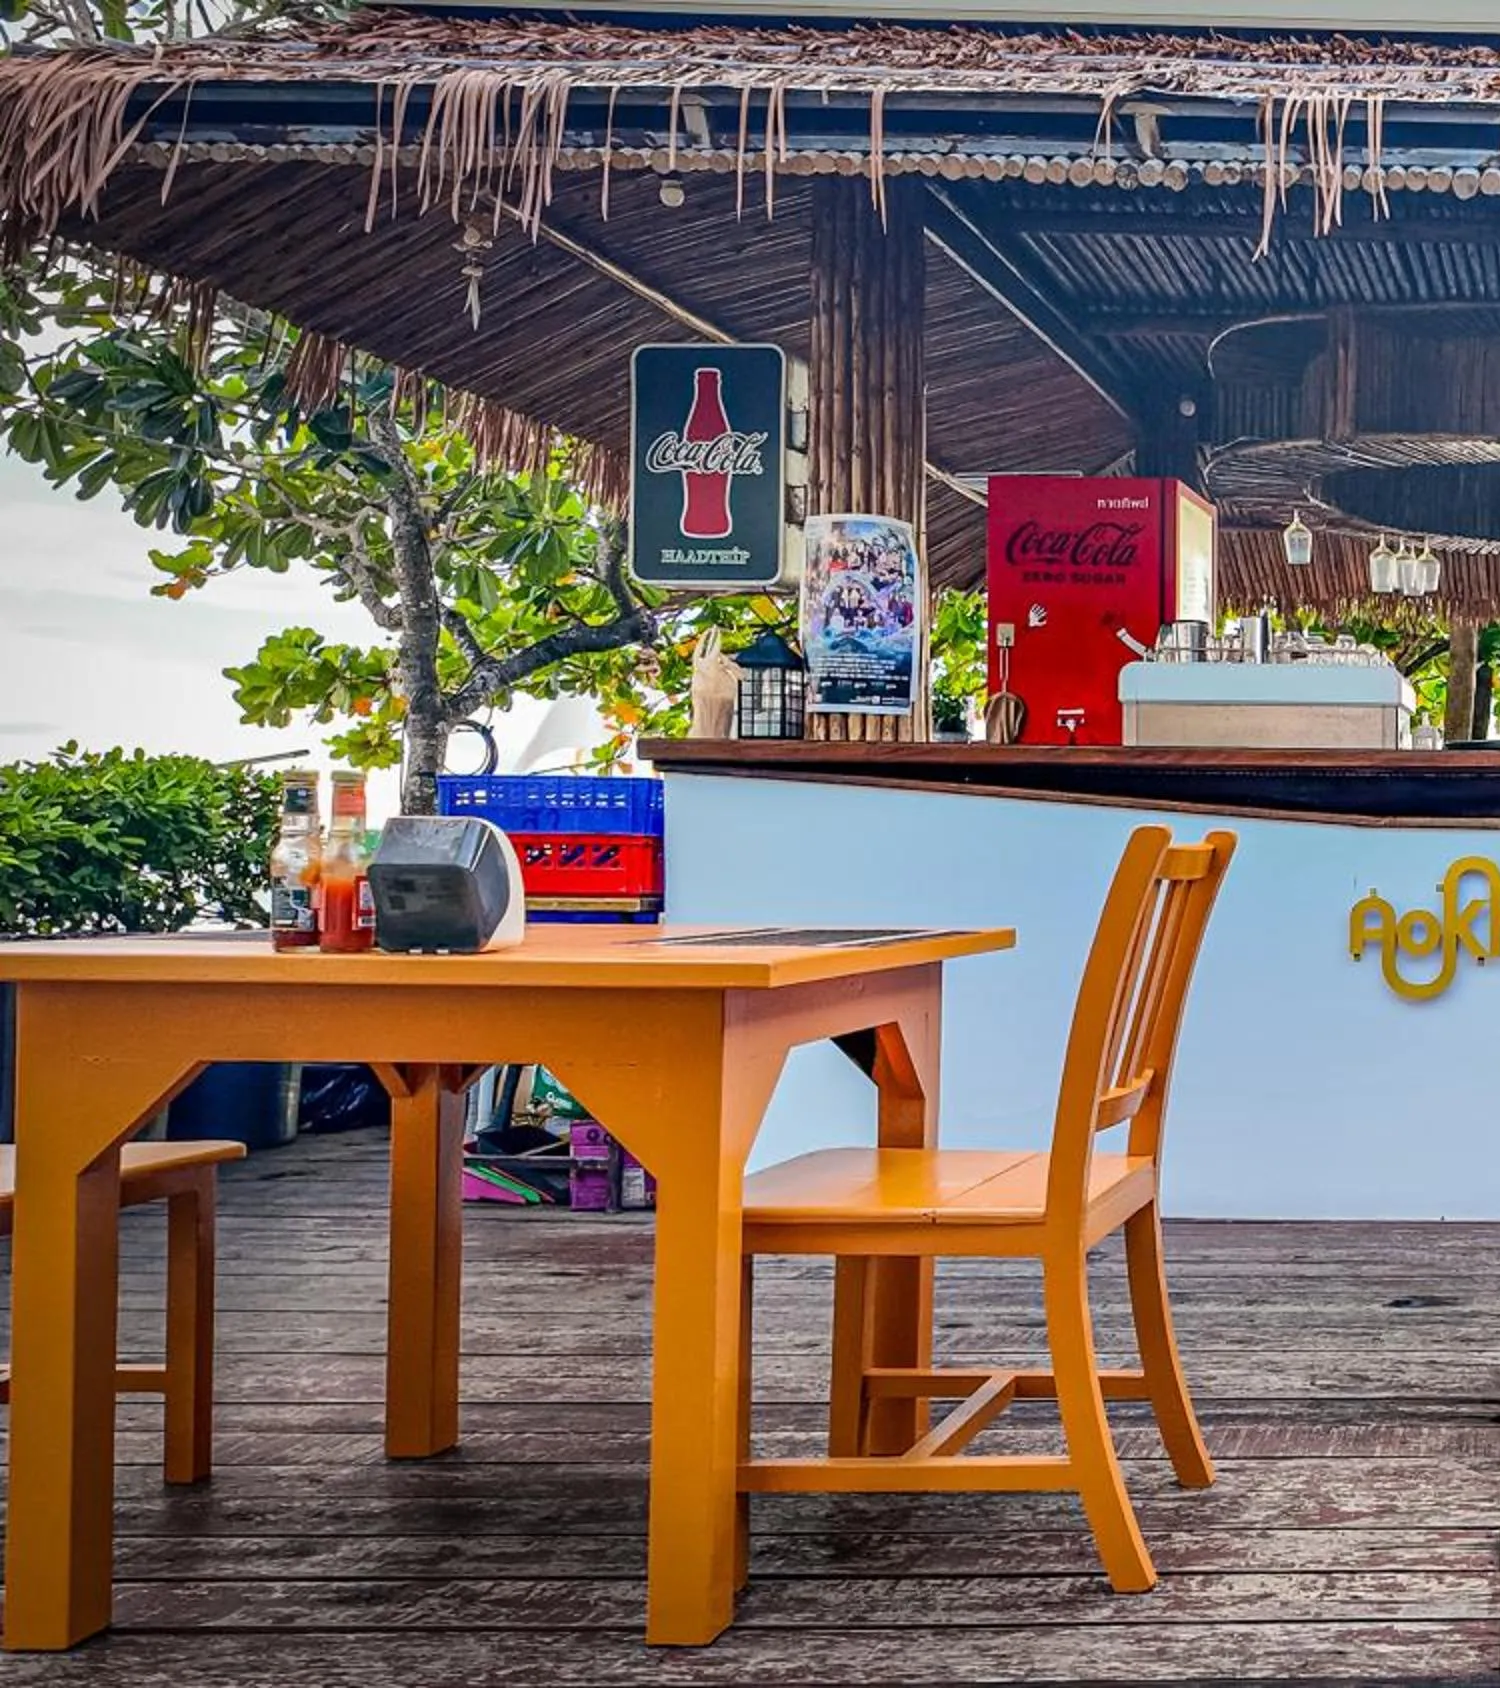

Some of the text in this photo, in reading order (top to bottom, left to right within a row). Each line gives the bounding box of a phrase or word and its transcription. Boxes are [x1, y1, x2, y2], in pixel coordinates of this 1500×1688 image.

[645, 431, 769, 474] Coca-Cola
[1005, 520, 1146, 566] Coca-Cola
[1022, 571, 1126, 586] ZERO SUGAR
